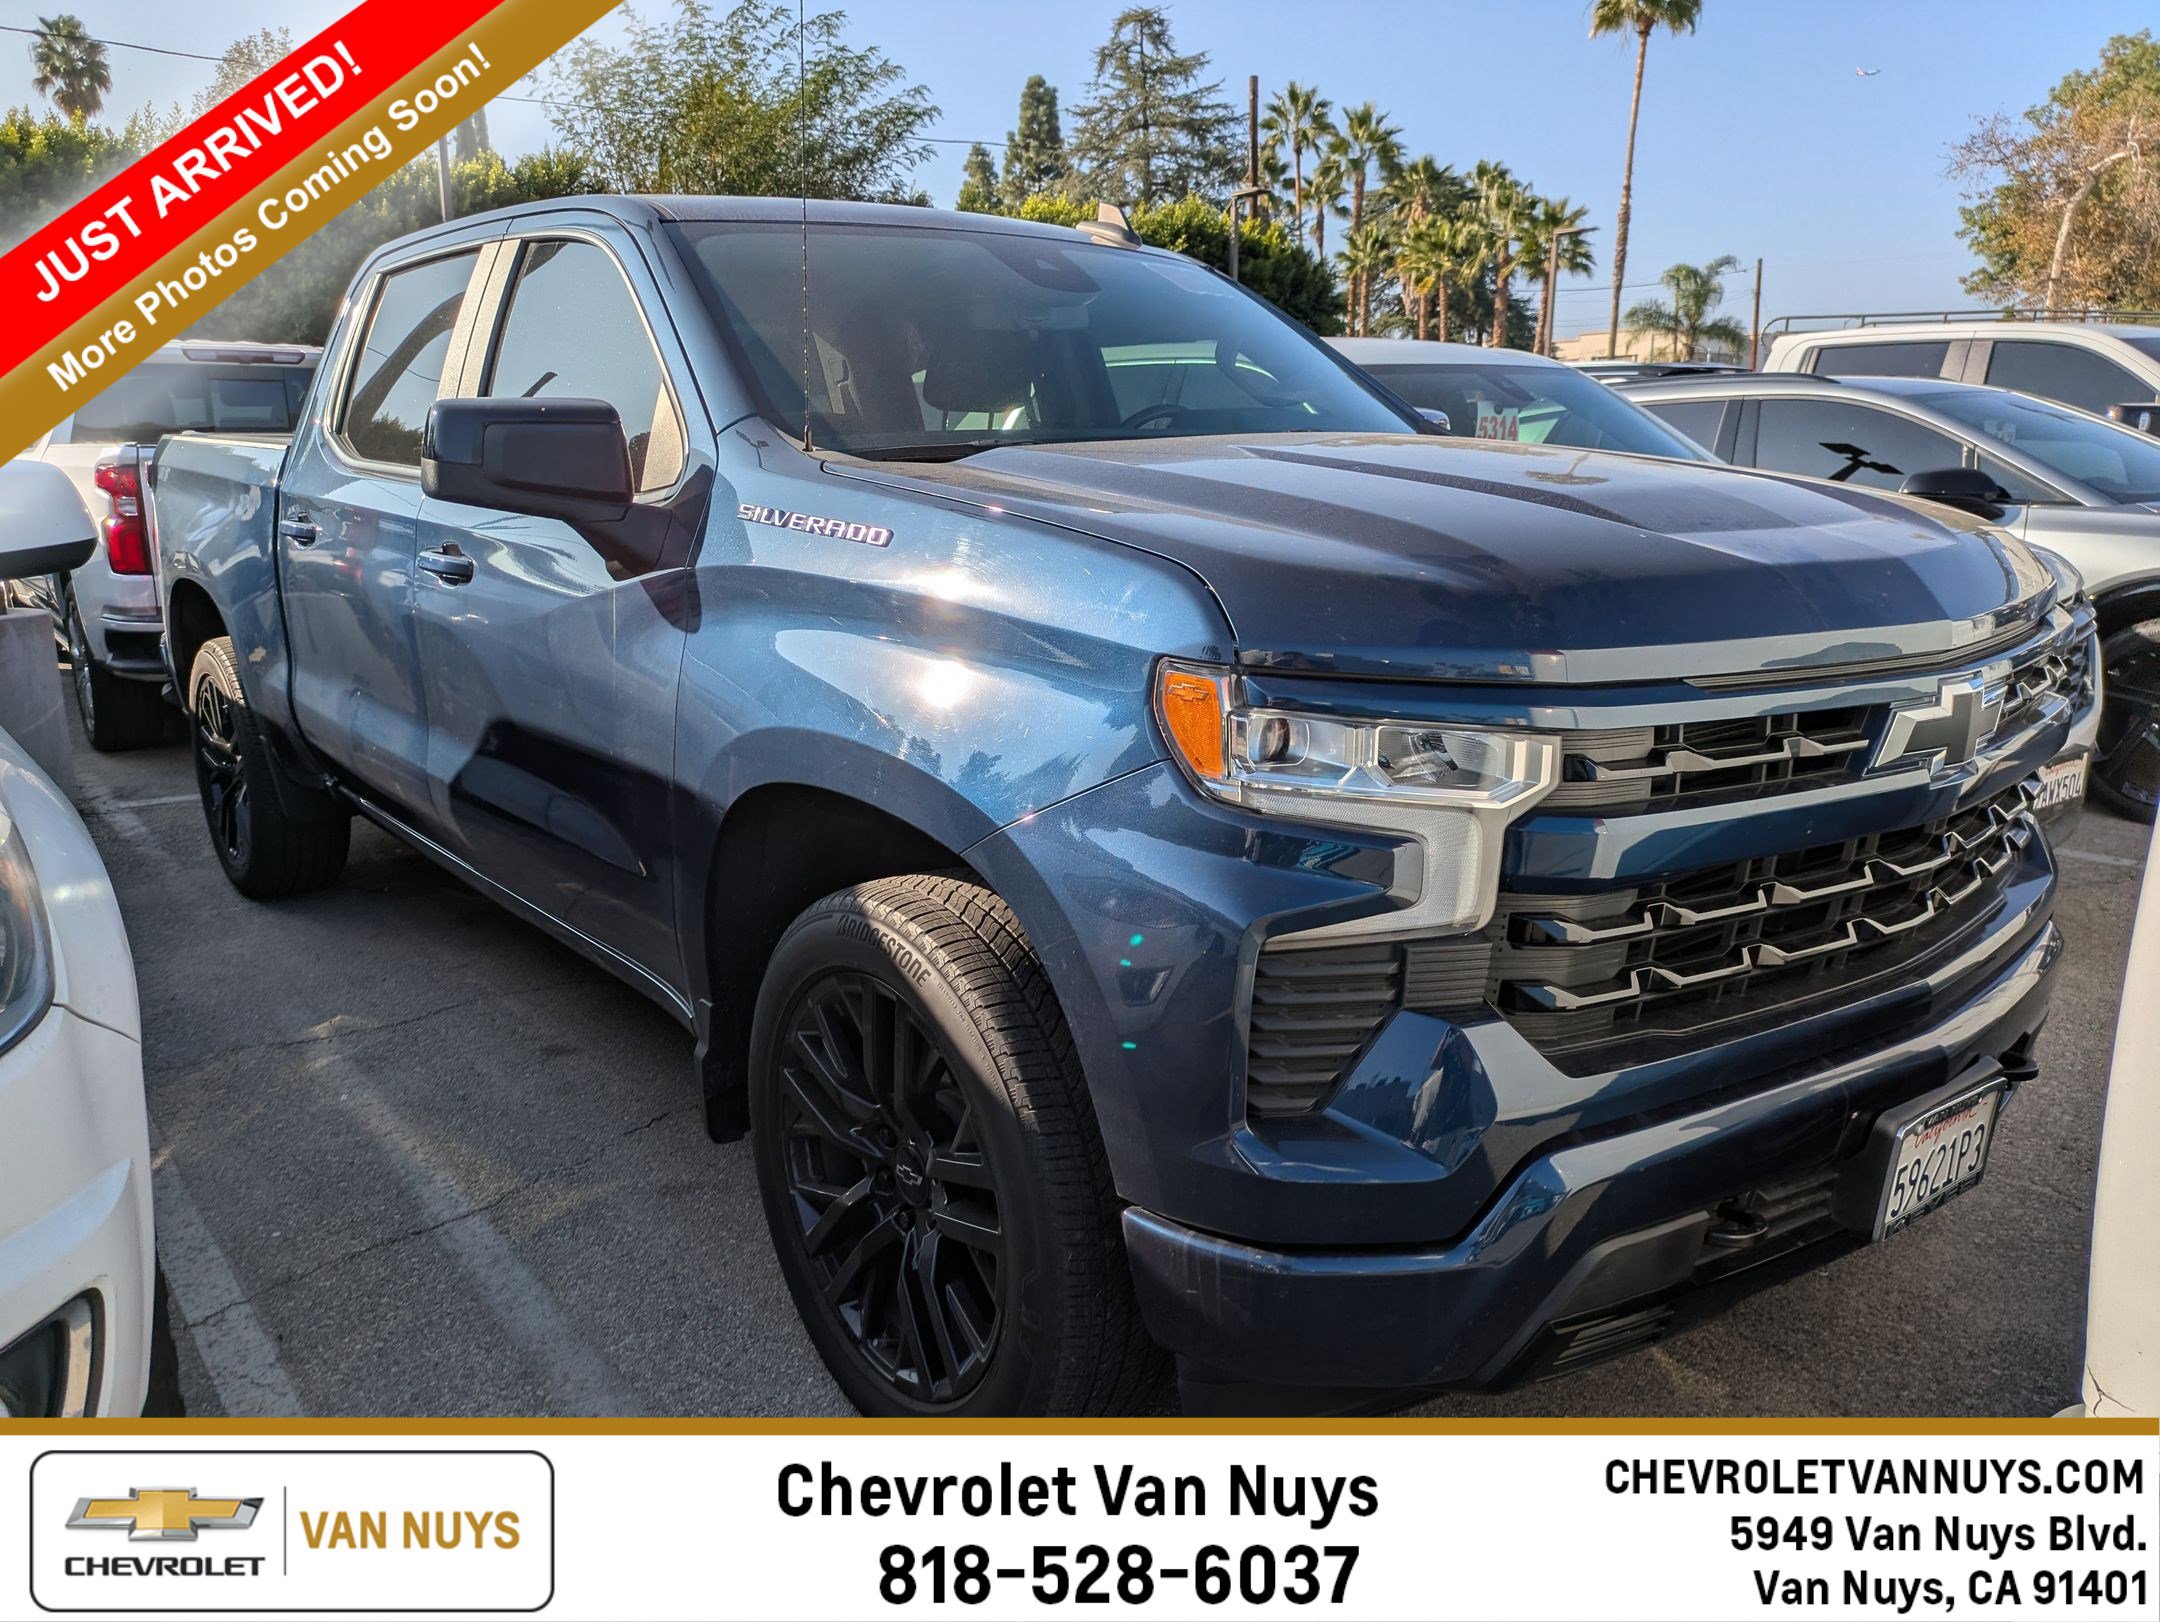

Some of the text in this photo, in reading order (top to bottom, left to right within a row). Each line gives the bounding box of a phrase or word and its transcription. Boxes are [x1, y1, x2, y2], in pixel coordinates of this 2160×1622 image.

[1478, 415, 1518, 441] 5314
[737, 503, 894, 548] SILVERADO
[836, 913, 931, 988] BRIDGESTONE
[1891, 1123, 1985, 1218] 59621P3
